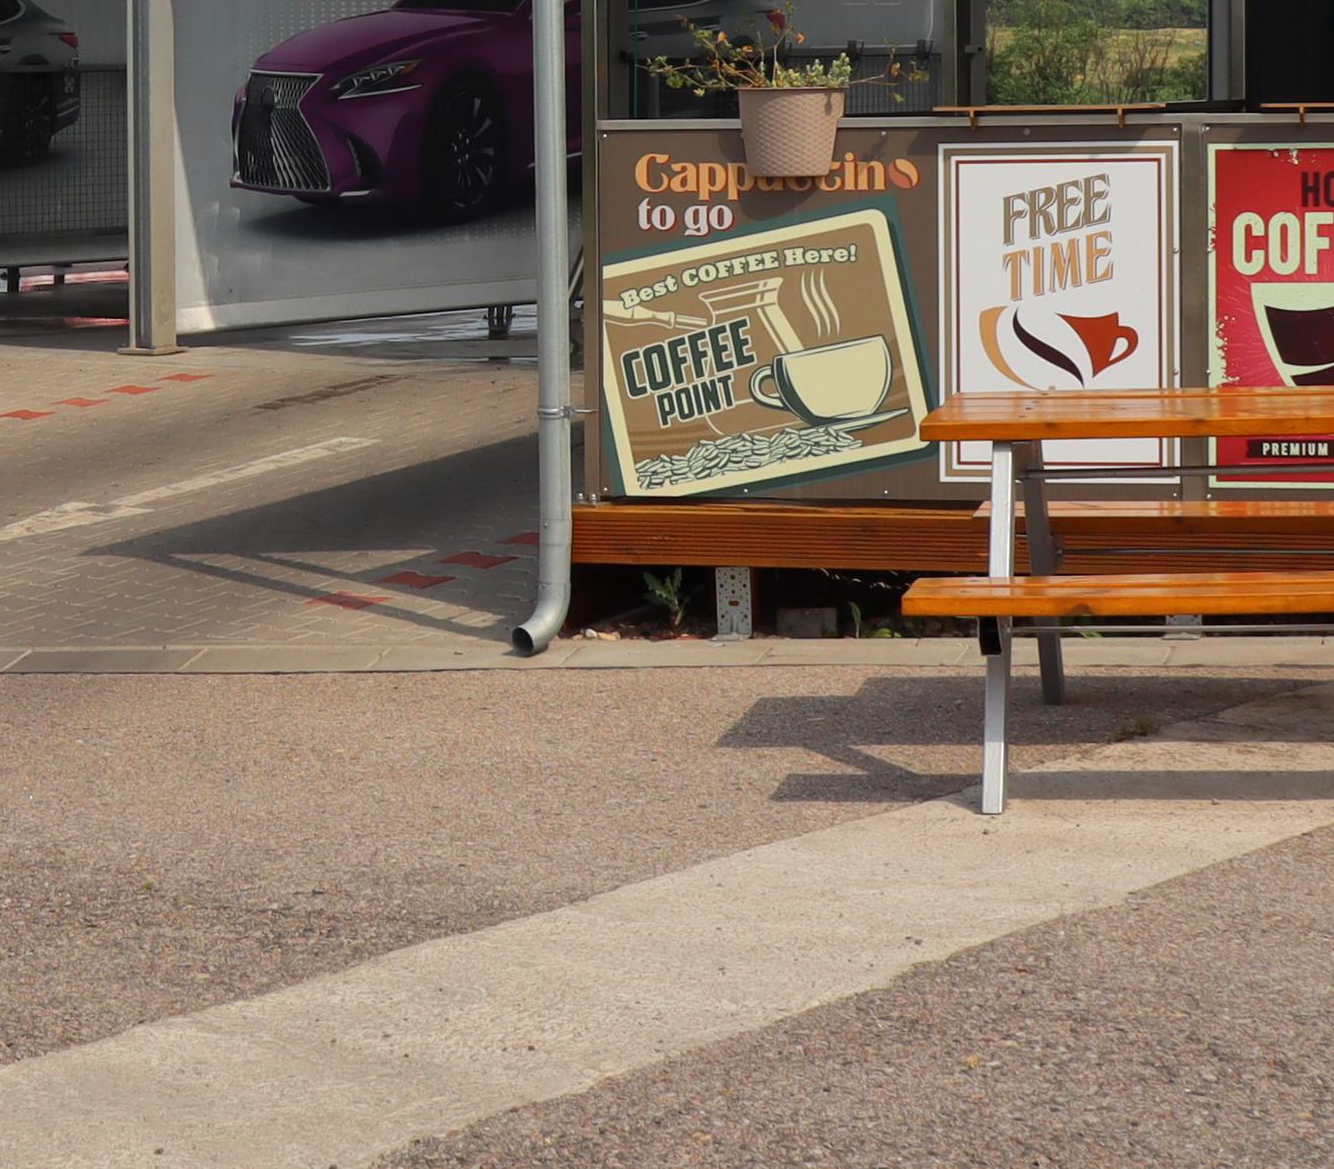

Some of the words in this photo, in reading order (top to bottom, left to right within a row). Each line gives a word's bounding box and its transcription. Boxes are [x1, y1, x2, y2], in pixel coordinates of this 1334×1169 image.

[637, 197, 676, 231] to
[684, 203, 735, 237] go
[1002, 173, 1112, 246] FREE
[619, 272, 679, 310] Best
[681, 248, 781, 288] COFFEE
[782, 243, 859, 267] Here!
[1002, 230, 1114, 302] TIME
[620, 315, 757, 400] COFFEE
[656, 373, 737, 428] POINT
[1262, 442, 1329, 457] PREMIUM
